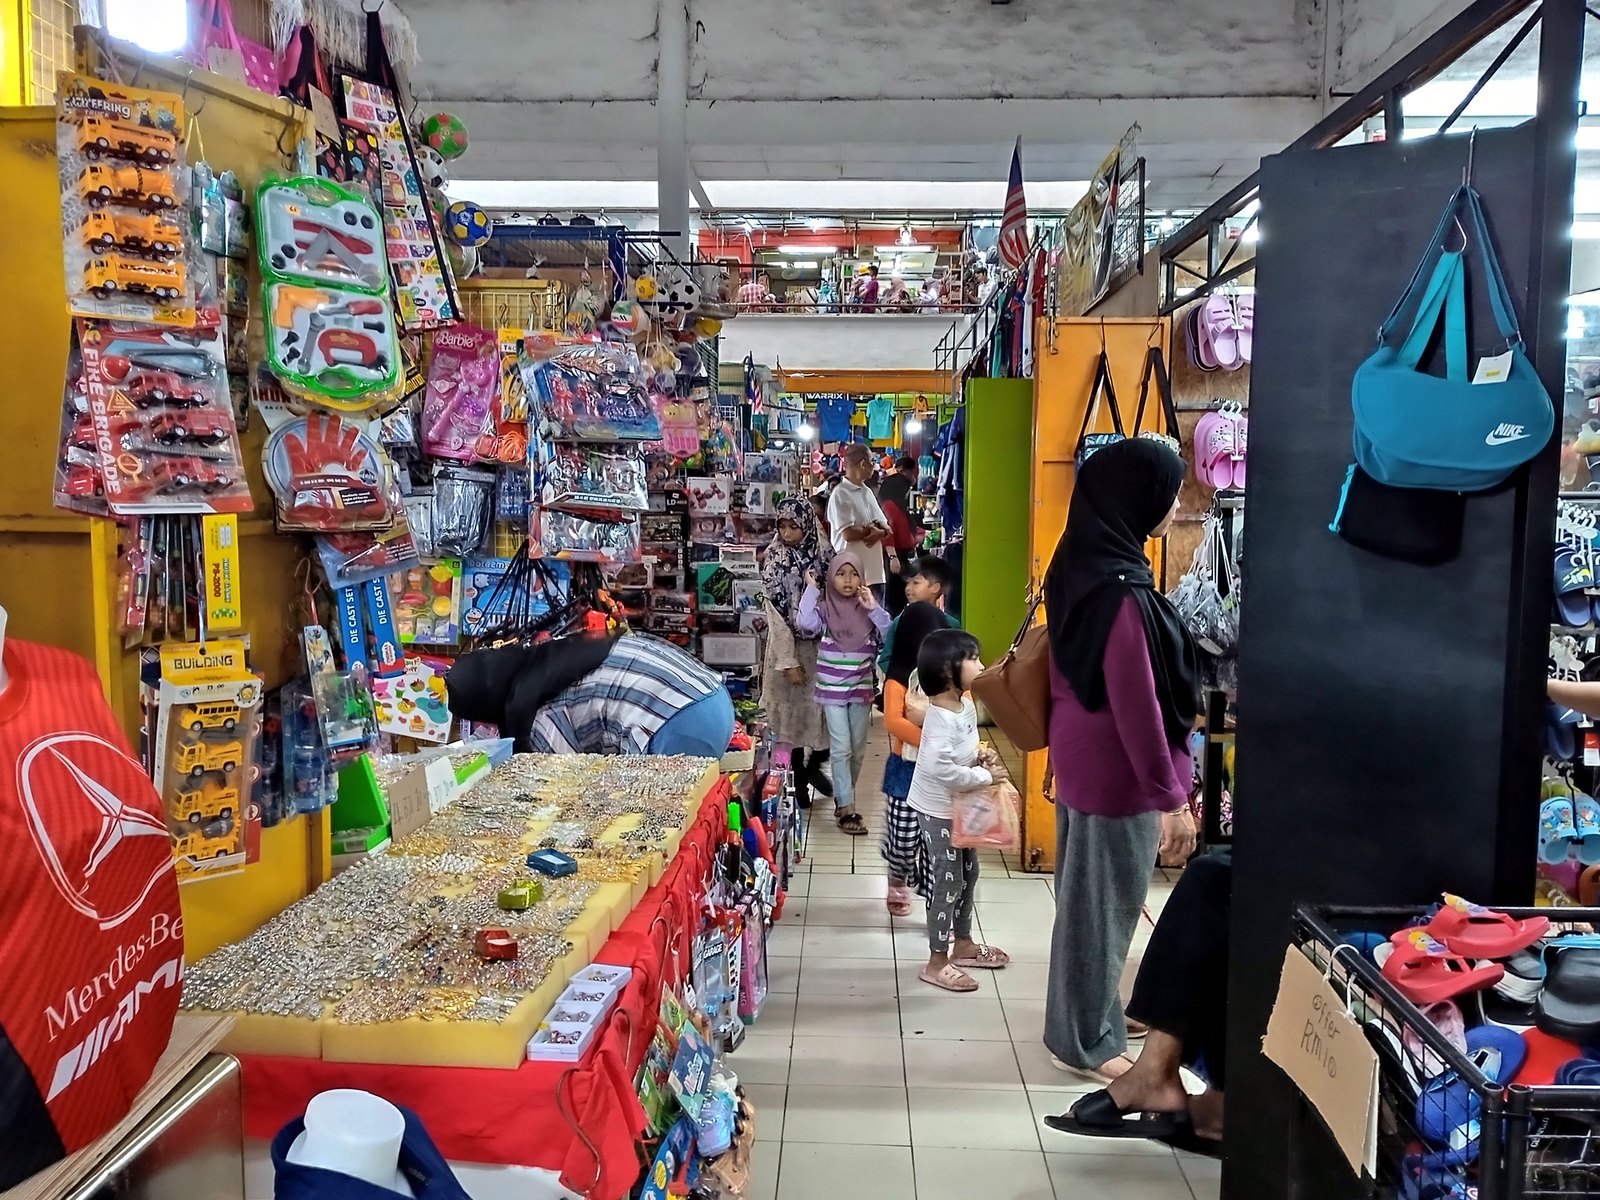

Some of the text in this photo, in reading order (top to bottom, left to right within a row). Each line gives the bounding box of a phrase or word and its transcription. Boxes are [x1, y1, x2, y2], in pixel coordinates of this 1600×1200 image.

[436, 331, 475, 349] Barbie
[84, 347, 121, 495] FIRE BRIGADE
[1494, 423, 1525, 437] NIKE
[373, 585, 385, 608] CAST
[345, 587, 359, 644] DIE CAST SET
[378, 609, 388, 625] DIE
[703, 943, 724, 959] GARAGE
